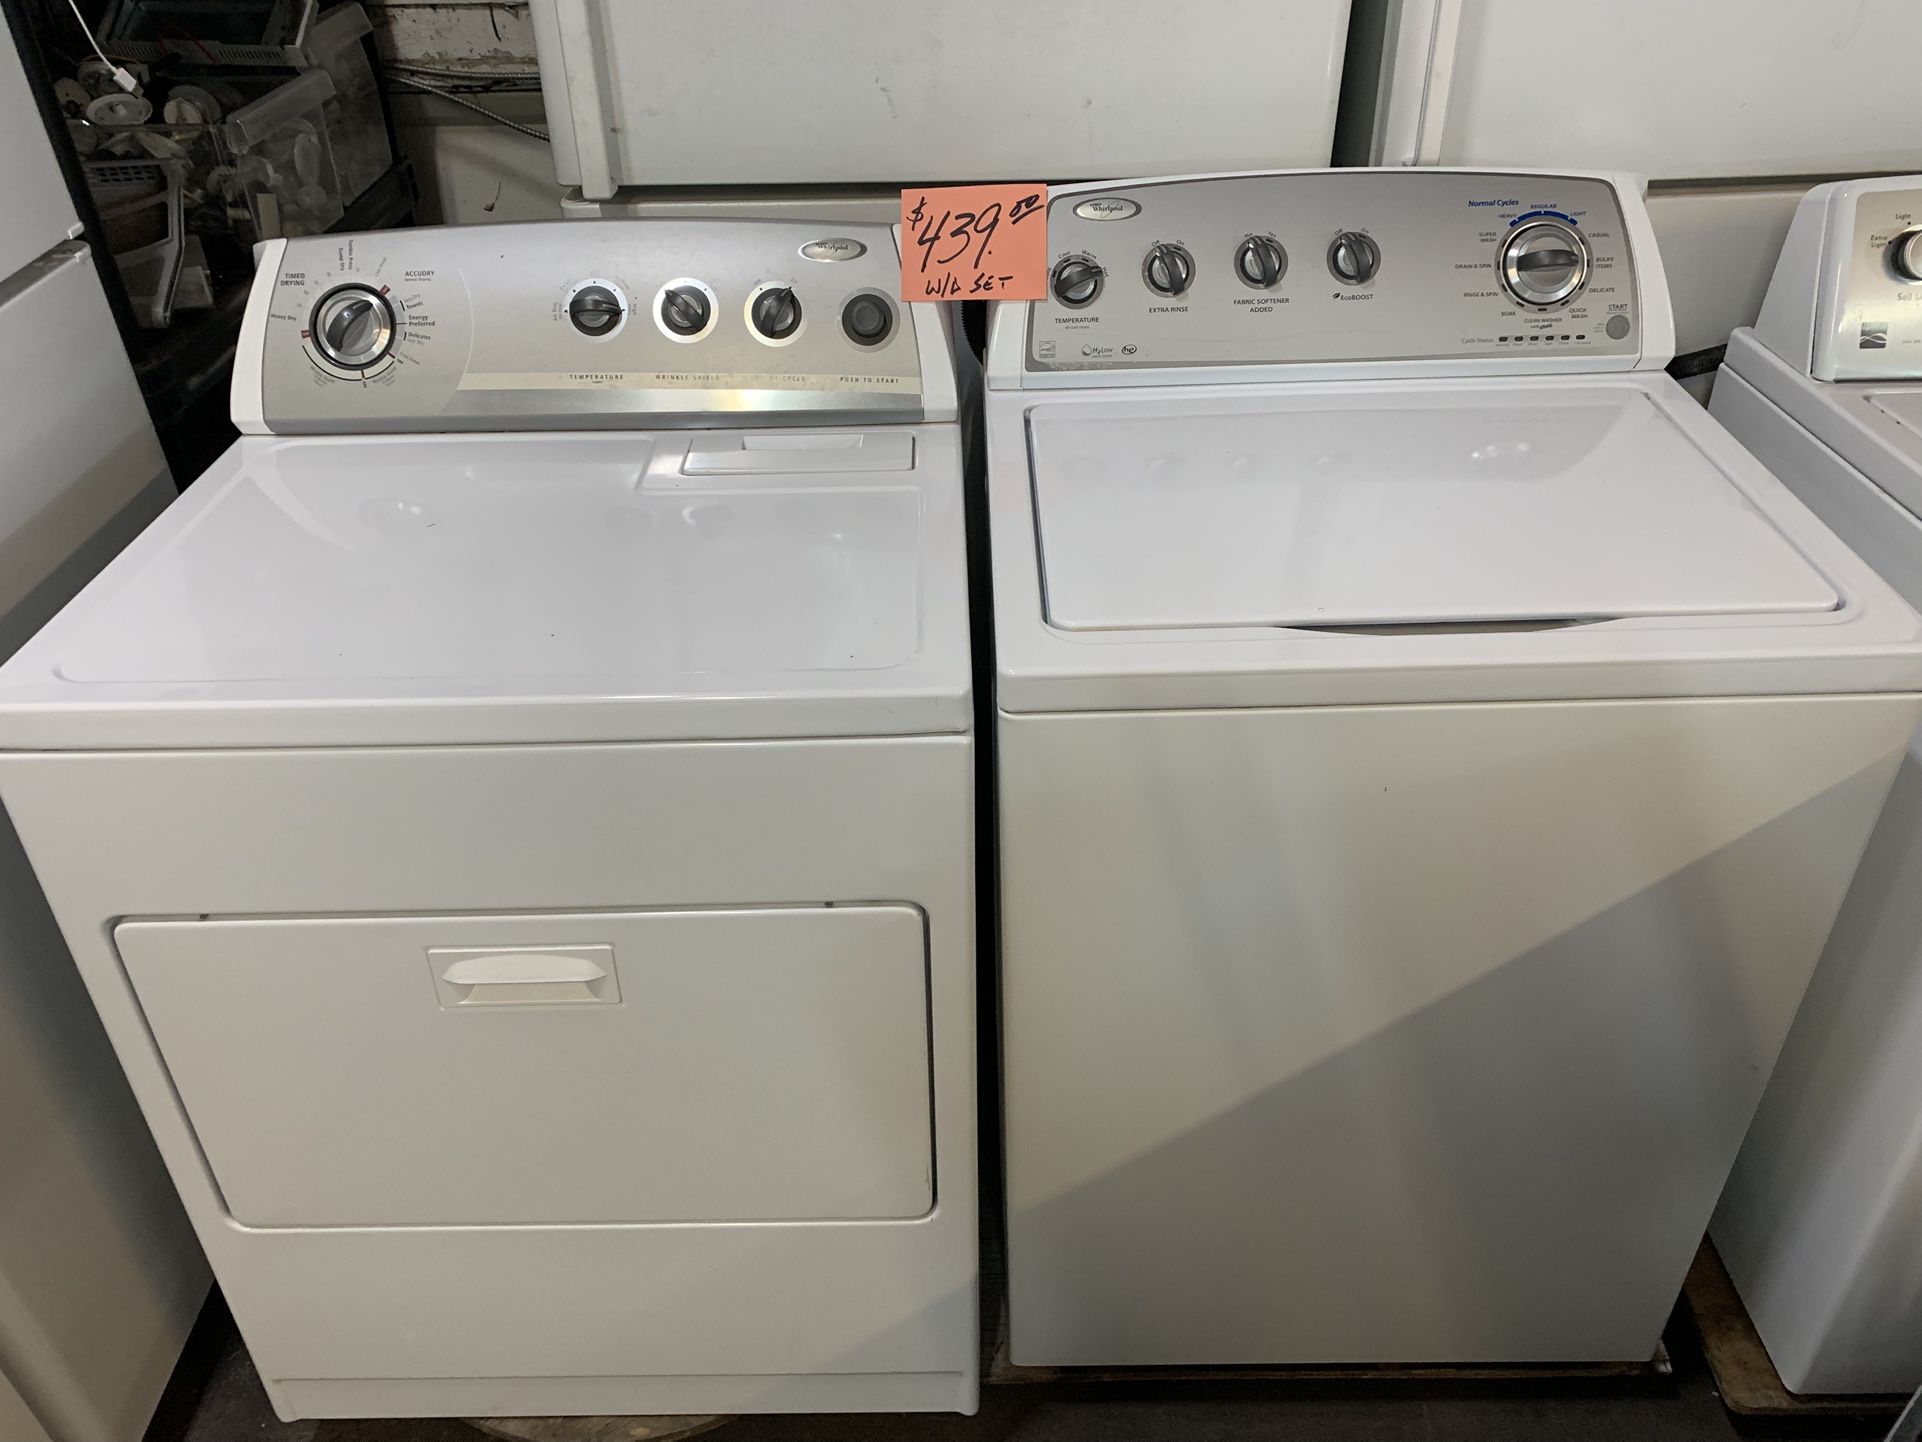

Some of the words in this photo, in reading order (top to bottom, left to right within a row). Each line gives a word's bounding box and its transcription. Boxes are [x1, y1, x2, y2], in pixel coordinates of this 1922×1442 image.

[1090, 203, 1123, 213] Whirlpool
[1496, 199, 1519, 208] Cycles
[1058, 250, 1071, 260] Cool
[1082, 250, 1098, 260] Warm
[969, 273, 1014, 294] SET
[1897, 292, 1912, 301] Soil
